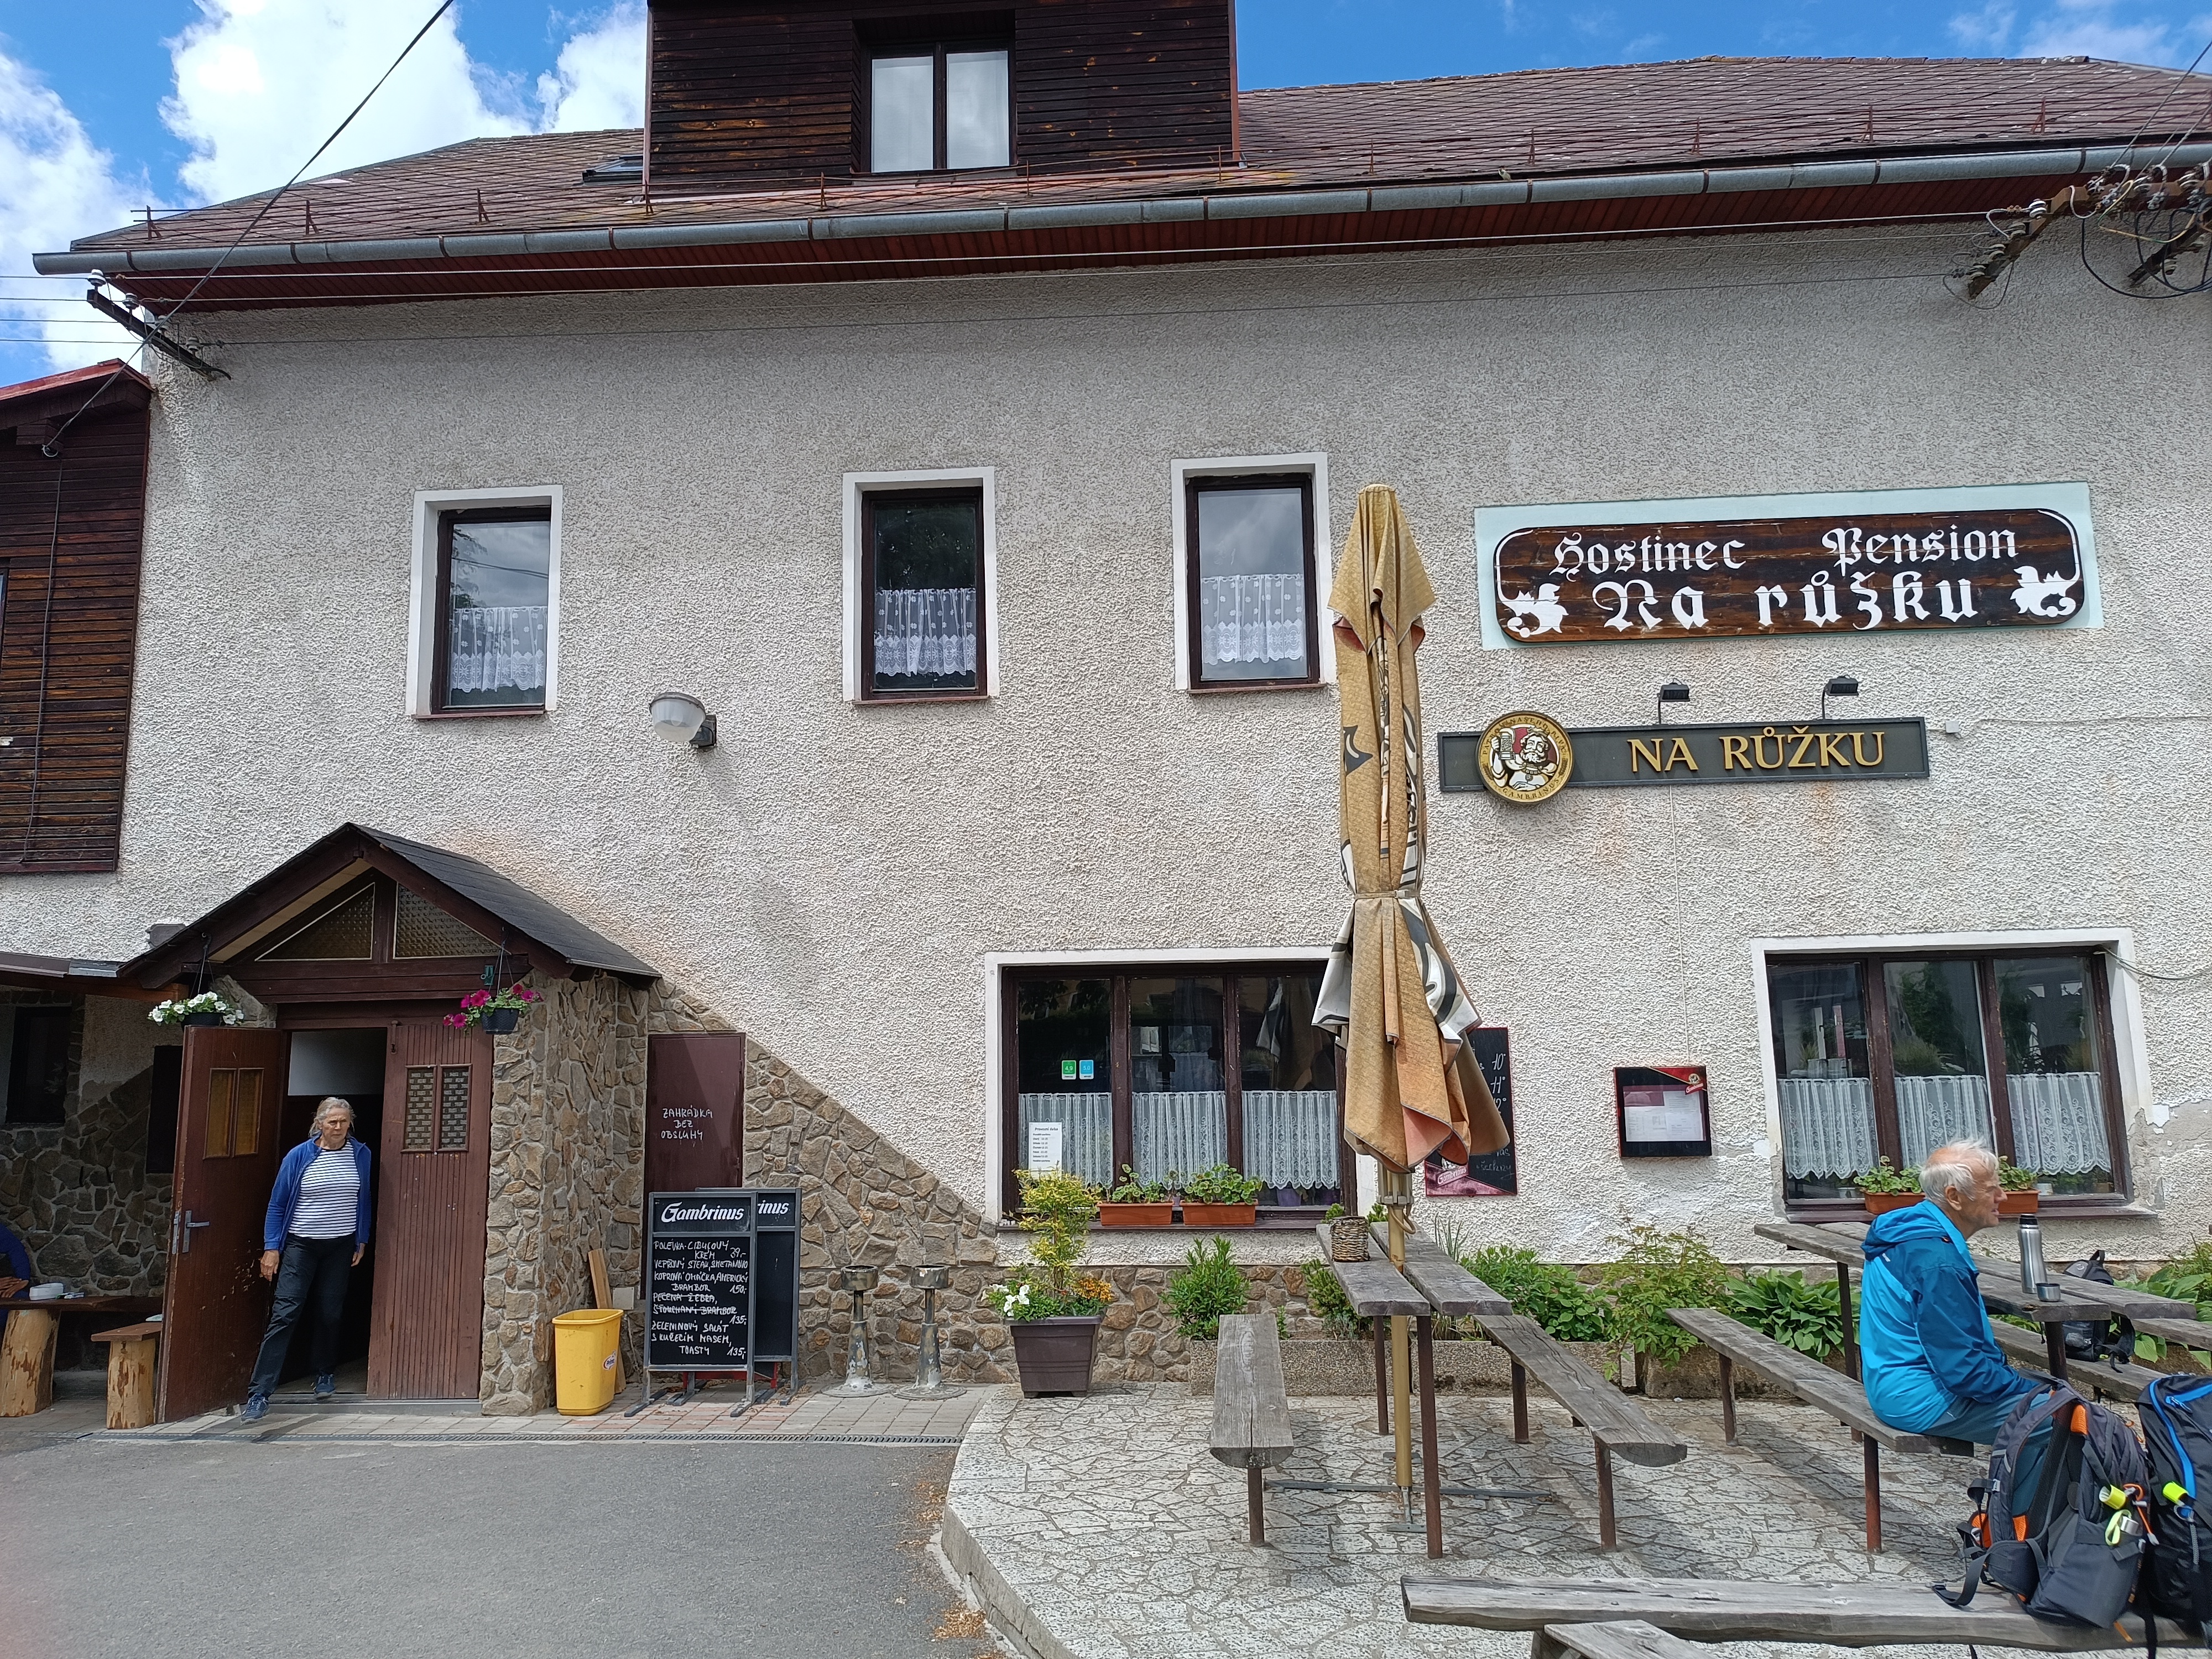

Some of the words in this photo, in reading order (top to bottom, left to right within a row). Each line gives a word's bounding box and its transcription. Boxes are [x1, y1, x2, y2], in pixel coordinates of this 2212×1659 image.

[1549, 532, 1746, 582] Hostinec
[1822, 524, 2019, 577] Pension
[1592, 579, 1709, 632] Na
[1754, 570, 1979, 630] růžku
[1627, 738, 1699, 773] NA
[1719, 726, 1885, 770] RŮŽKU
[1503, 778, 1559, 800] GAMBRINUS
[662, 1104, 713, 1119] ZAHRÁDKA
[673, 1119, 693, 1129] BEZ
[661, 1129, 703, 1140] OBSLUHY
[1437, 1167, 1467, 1185] Gambrinus
[661, 1201, 745, 1223] Gambrinus
[671, 1283, 711, 1292] BRAMBOR
[702, 1320, 729, 1333] SALÁT
[651, 1333, 657, 1342] S
[679, 1345, 710, 1355] TOASTY
